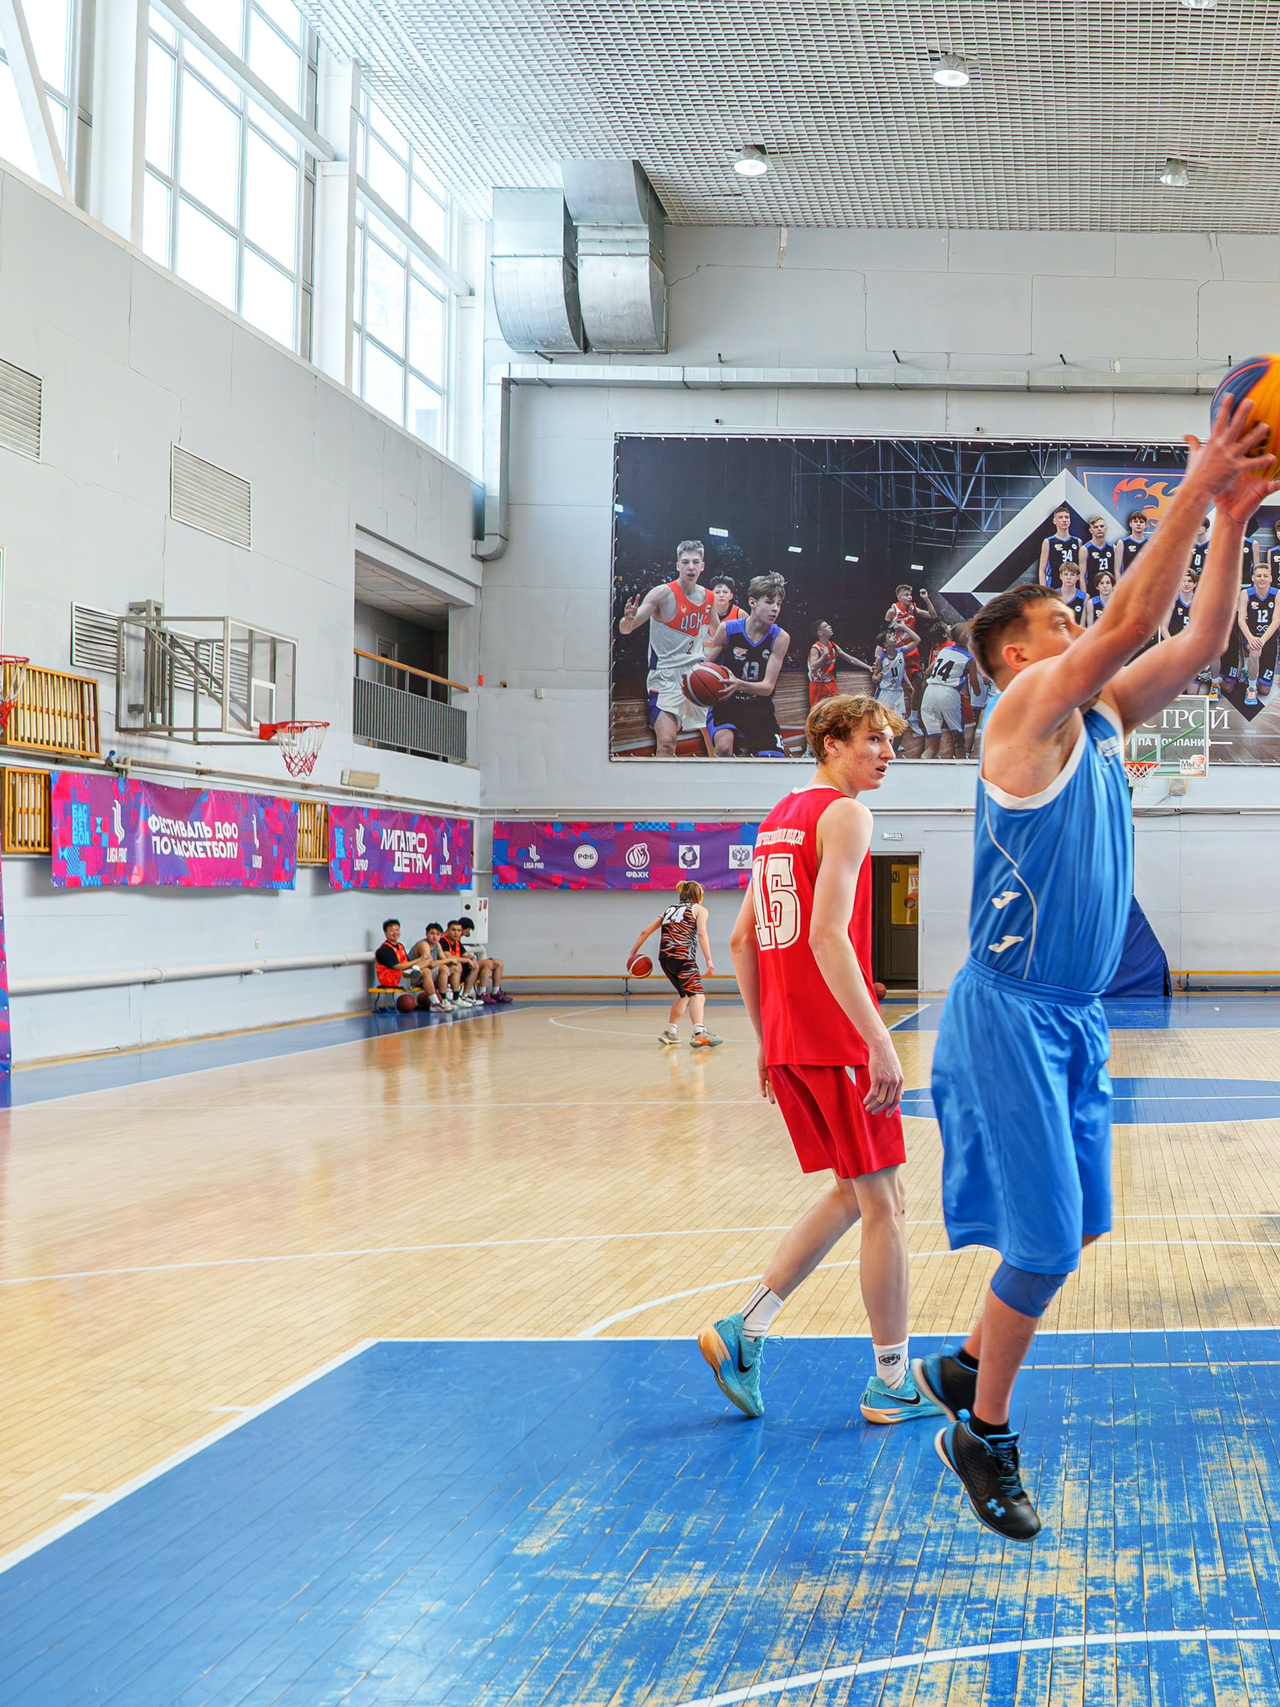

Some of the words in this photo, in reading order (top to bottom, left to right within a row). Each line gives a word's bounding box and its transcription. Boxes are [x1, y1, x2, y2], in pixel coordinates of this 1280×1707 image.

[1257, 609, 1269, 623] 12
[71, 804, 88, 818] БАС
[147, 813, 213, 840] ФЕСТИВАЛЬ
[214, 821, 239, 840] ДФО
[151, 835, 172, 856] ПО
[171, 838, 238, 859] БАСКЕТБОЛУ
[393, 851, 433, 875] ДЕТЯМ
[625, 871, 649, 879] ФБХК
[661, 906, 688, 925] 24
